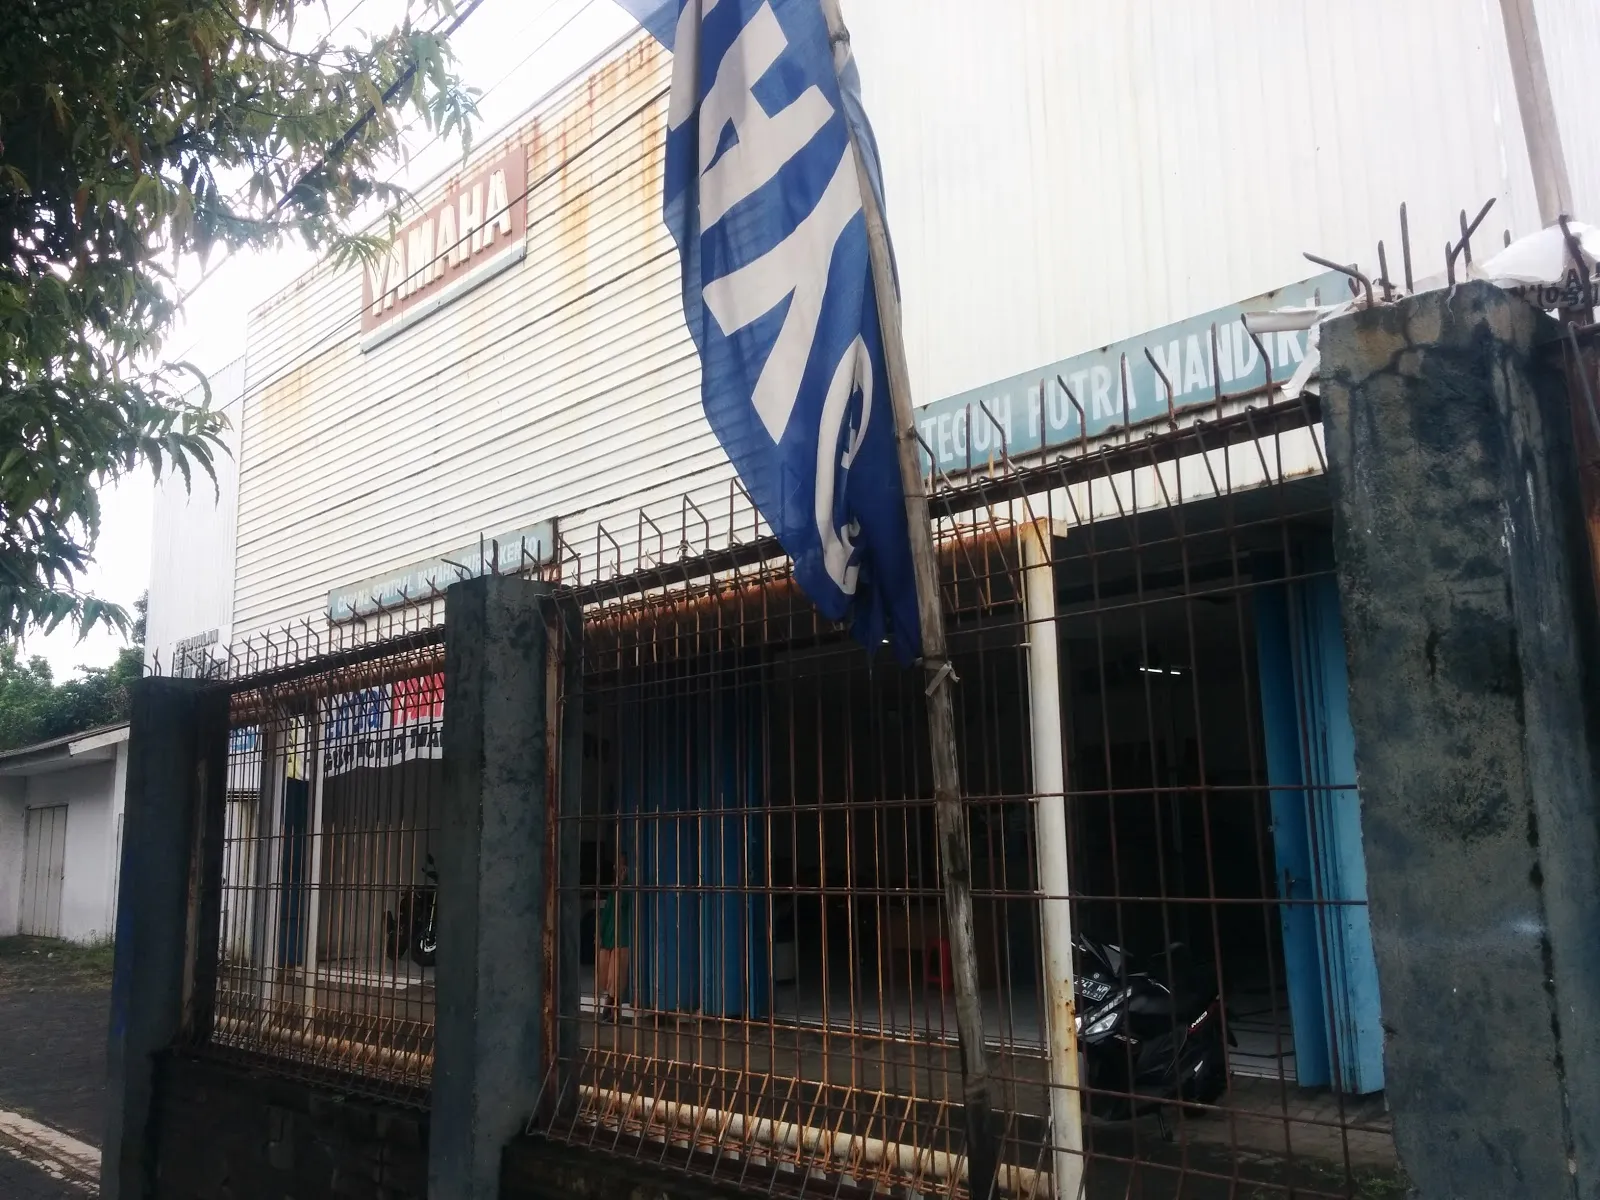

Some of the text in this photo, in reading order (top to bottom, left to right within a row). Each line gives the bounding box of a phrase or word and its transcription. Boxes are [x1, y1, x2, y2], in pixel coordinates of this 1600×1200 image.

[367, 168, 512, 317] YAMAHA
[921, 297, 1320, 466] TEGUH PUTRA MANDIR
